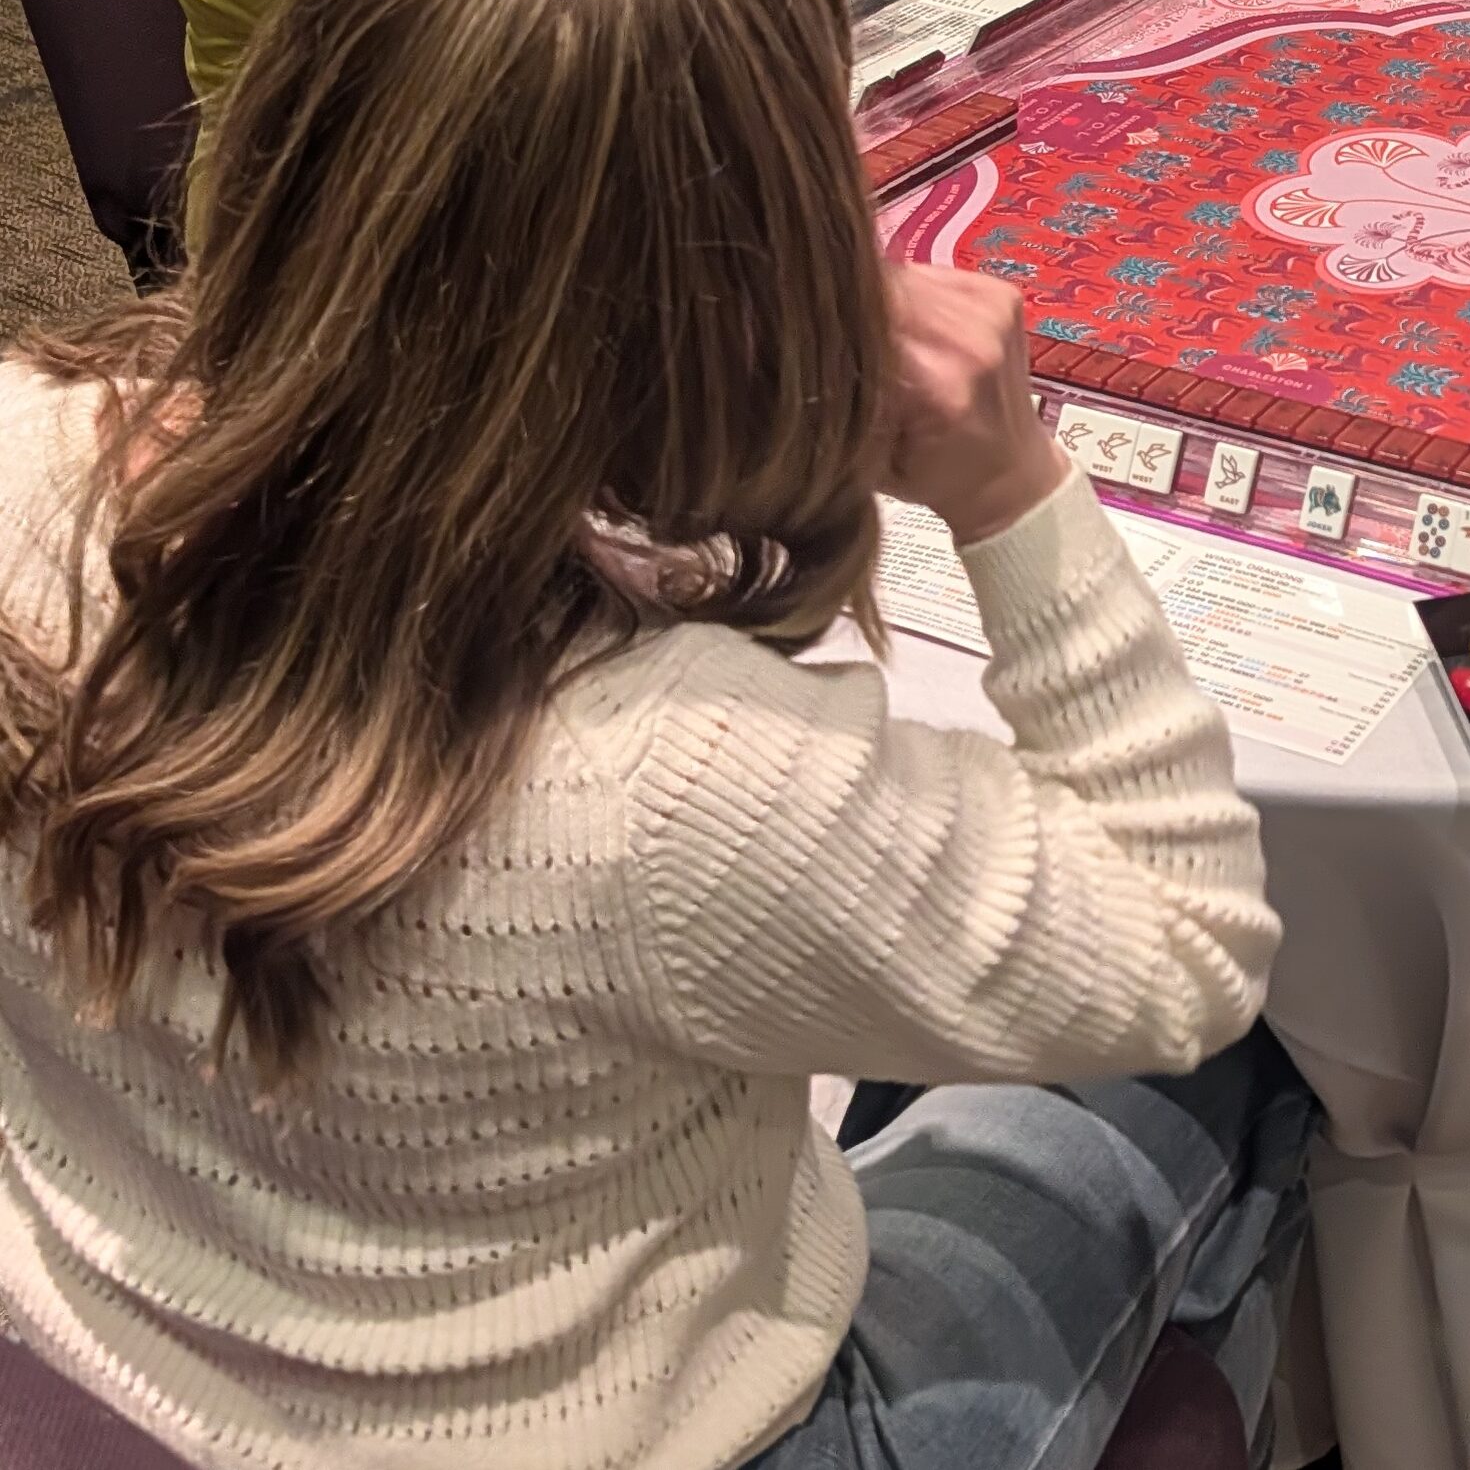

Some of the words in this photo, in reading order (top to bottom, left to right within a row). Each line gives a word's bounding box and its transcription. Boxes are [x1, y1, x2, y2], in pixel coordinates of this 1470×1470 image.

[1221, 364, 1304, 390] CHARLESTON
[1092, 463, 1114, 474] WEST
[1131, 474, 1153, 484] WEST
[1219, 495, 1240, 506] EAST
[1306, 521, 1332, 533] JOKER
[1205, 553, 1241, 568] WINDS
[1246, 563, 1305, 585] DRAGONS
